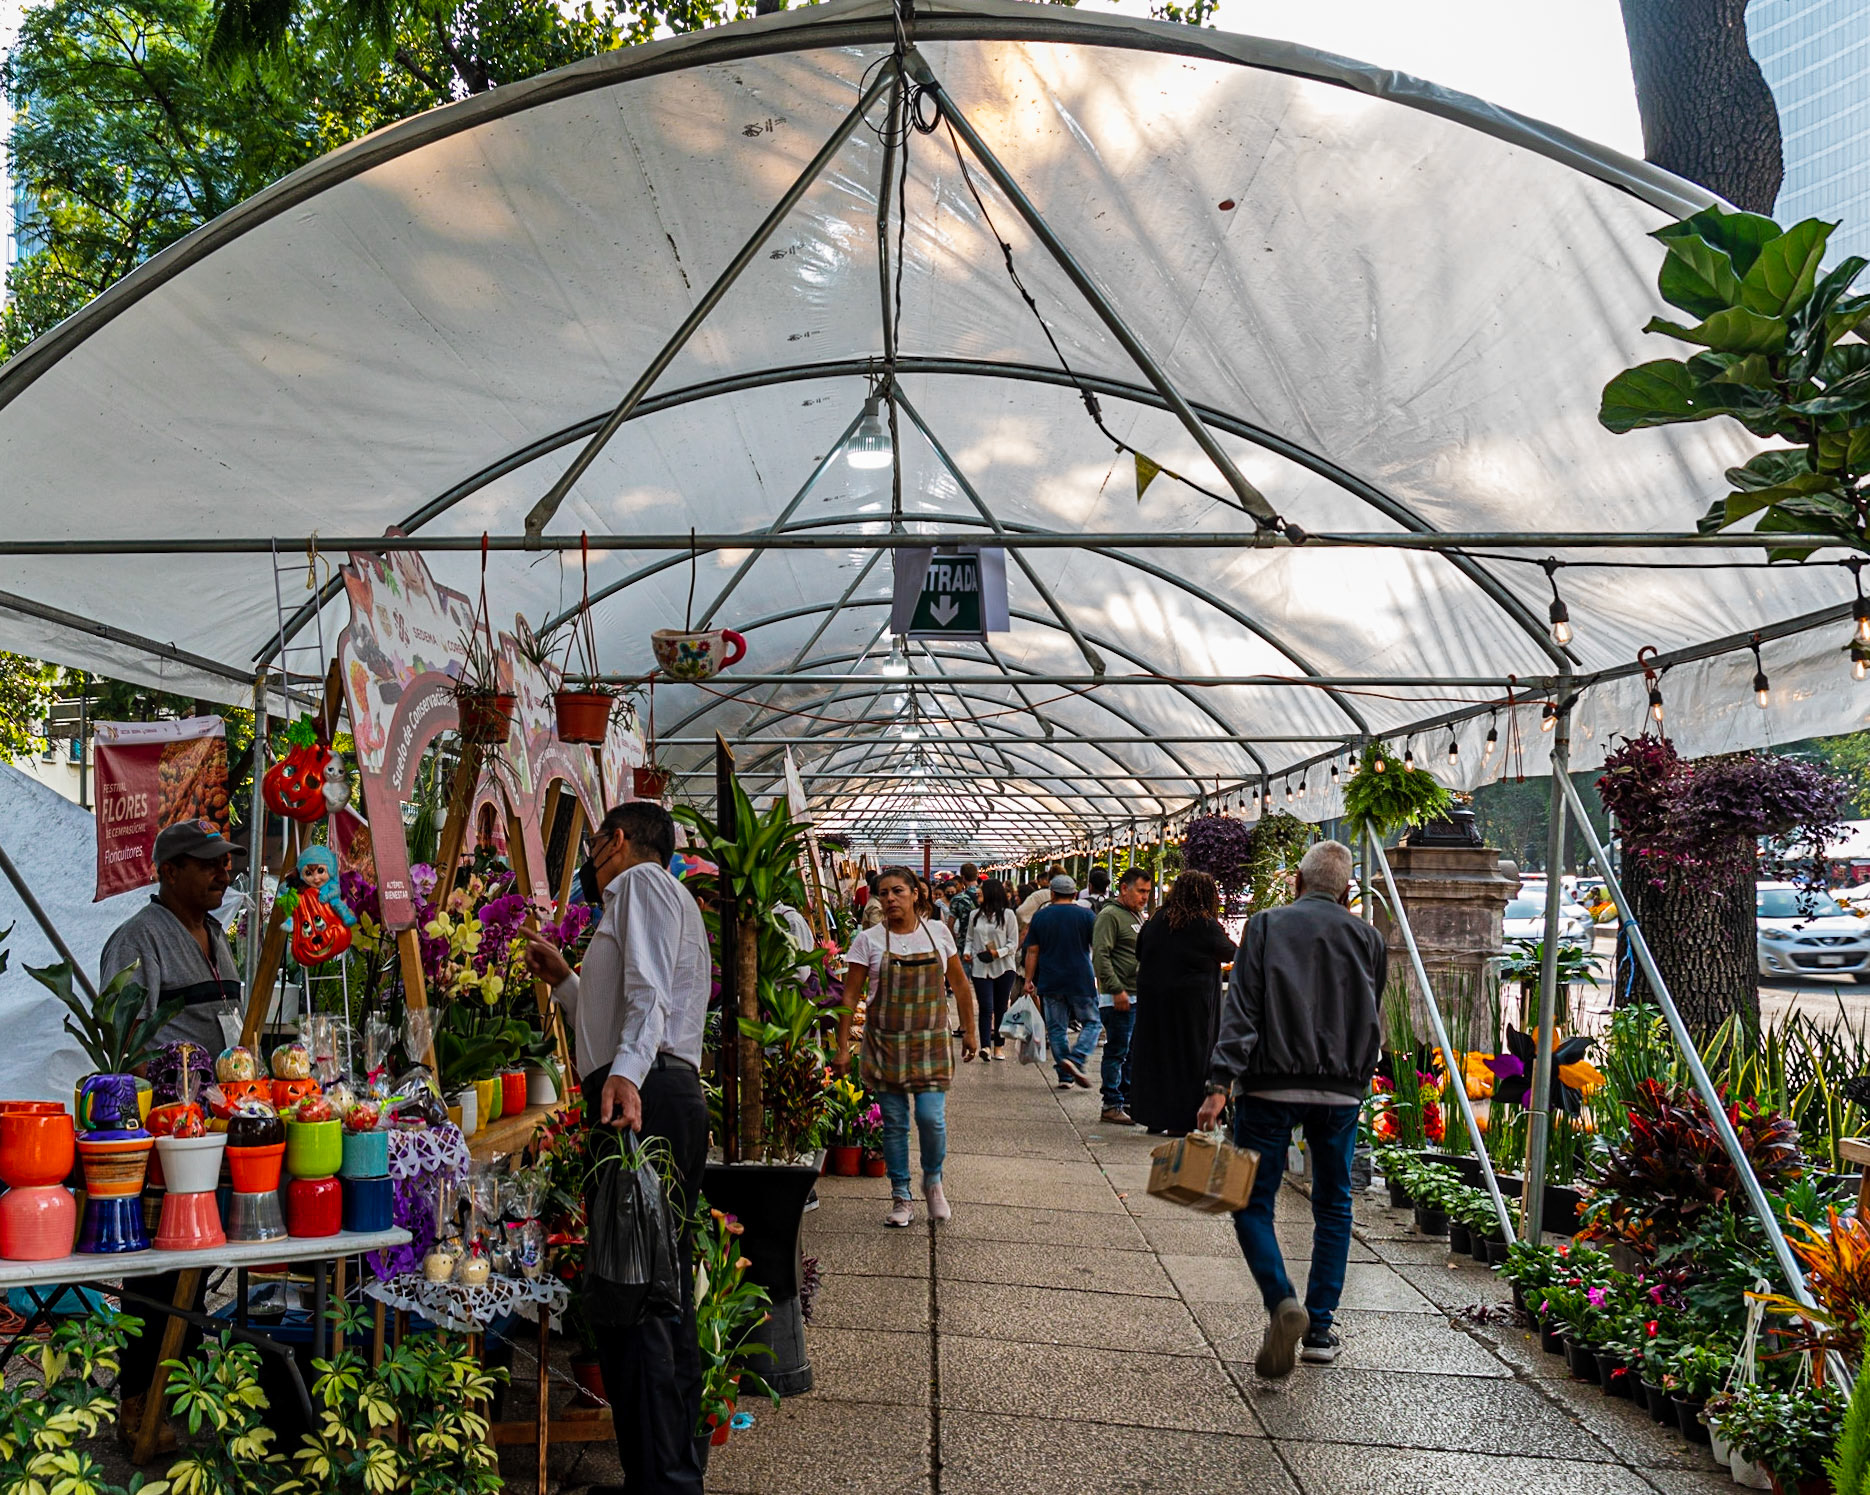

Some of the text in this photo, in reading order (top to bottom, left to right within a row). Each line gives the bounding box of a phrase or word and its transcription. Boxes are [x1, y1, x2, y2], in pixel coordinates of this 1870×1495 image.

[922, 564, 979, 592] TRADA
[412, 626, 438, 646] SEDEMA
[392, 743, 408, 792] Suelo
[402, 724, 413, 747] de
[103, 781, 127, 793] FESTIVAL
[101, 793, 148, 824] FLORES
[112, 822, 147, 838] CEMPASÚCHIL
[104, 845, 143, 865] Floricultores
